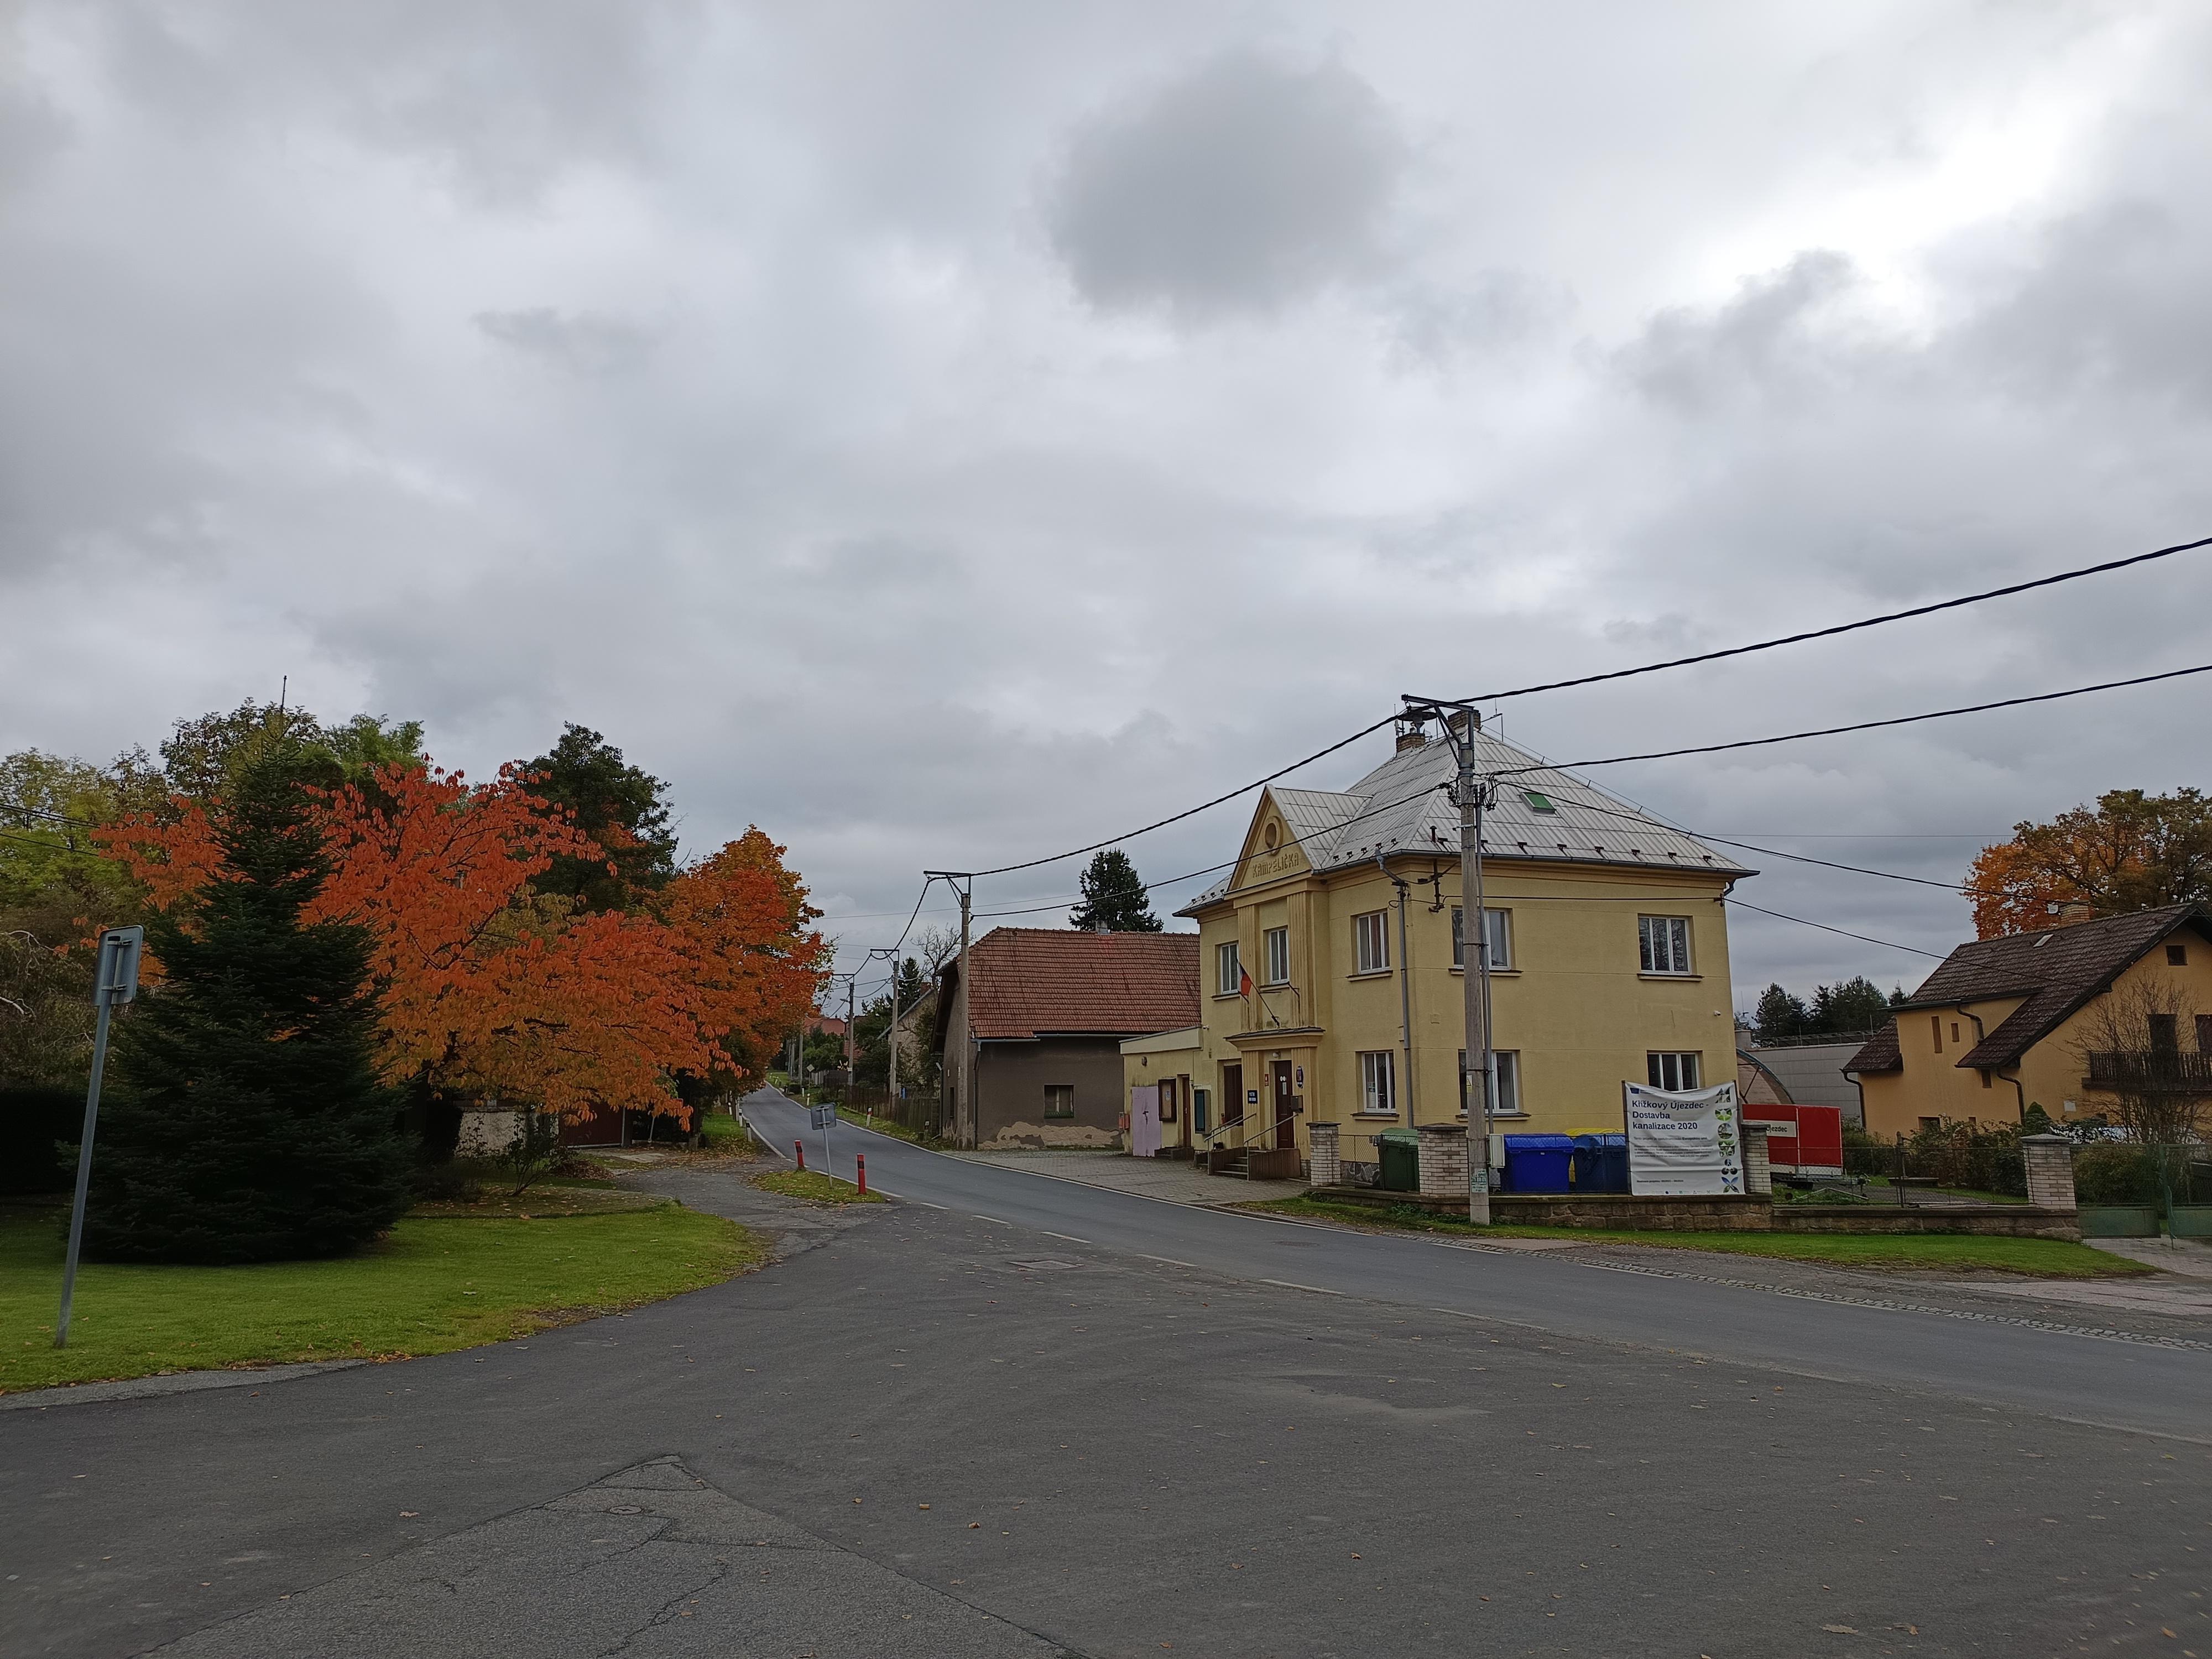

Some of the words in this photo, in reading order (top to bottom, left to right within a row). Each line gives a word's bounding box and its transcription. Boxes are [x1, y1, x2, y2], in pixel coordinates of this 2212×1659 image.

[1632, 1100, 1668, 1110] Křížkový
[1671, 1100, 1704, 1110] Újezdec
[1632, 1111, 1670, 1119] Dostavba
[1633, 1121, 1676, 1130] kanalizace
